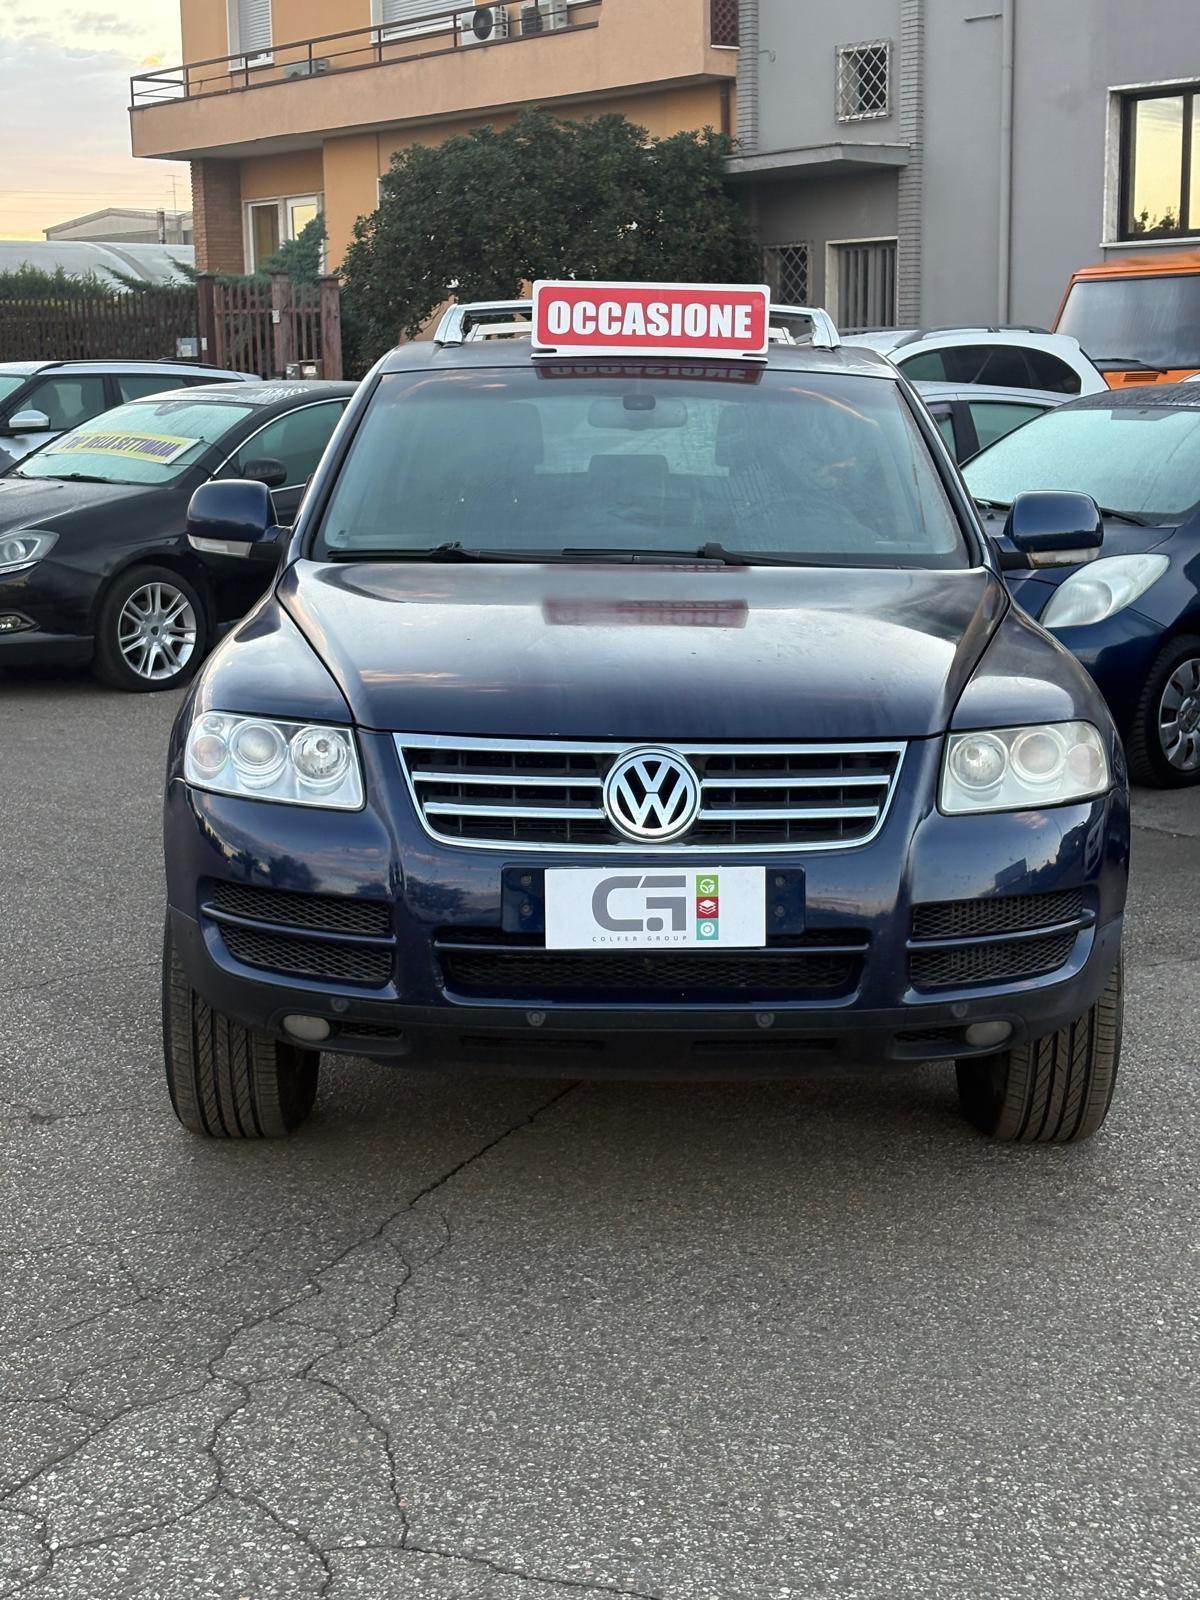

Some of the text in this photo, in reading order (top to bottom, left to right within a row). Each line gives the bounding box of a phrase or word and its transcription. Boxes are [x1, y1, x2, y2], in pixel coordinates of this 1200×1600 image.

[547, 300, 752, 338] OCCASIONE
[110, 437, 182, 458] SETTIMANA
[606, 750, 699, 839] VW
